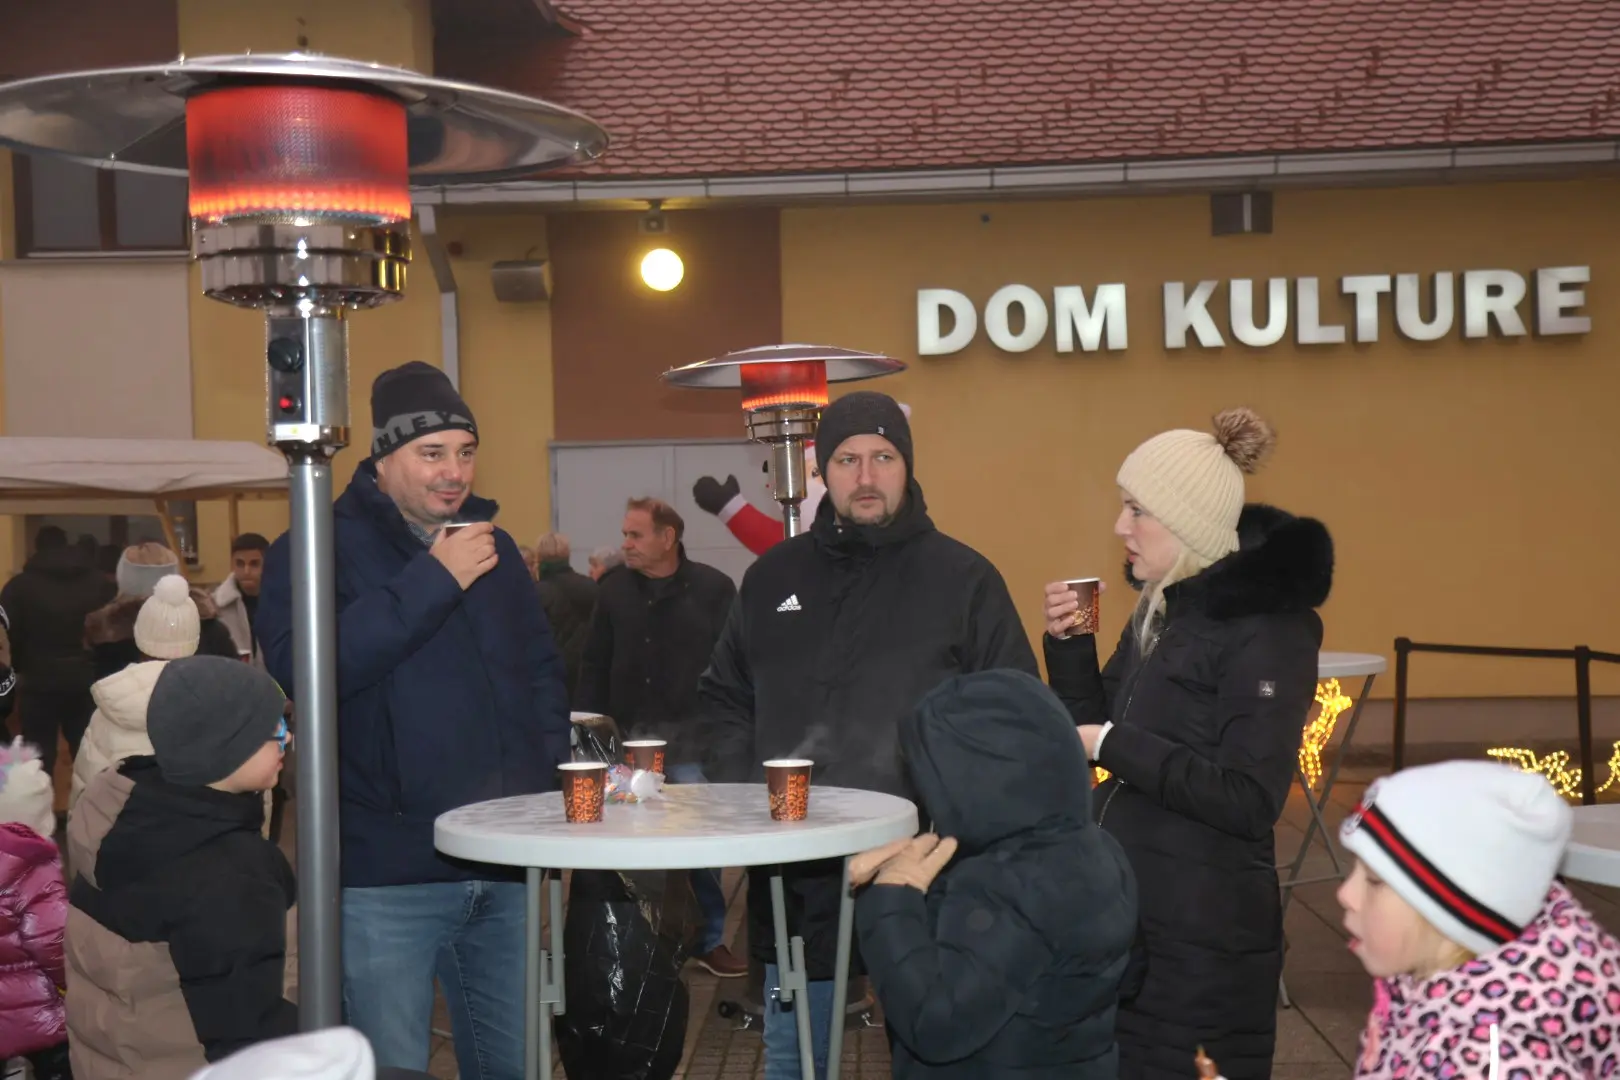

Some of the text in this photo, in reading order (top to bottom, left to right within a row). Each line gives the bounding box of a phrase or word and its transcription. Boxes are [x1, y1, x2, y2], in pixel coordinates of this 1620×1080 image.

[917, 266, 1592, 355] DOM KULTURE
[777, 604, 802, 612] adidas
[573, 776, 583, 819] COFFEE
[787, 774, 797, 816] COFFEE
